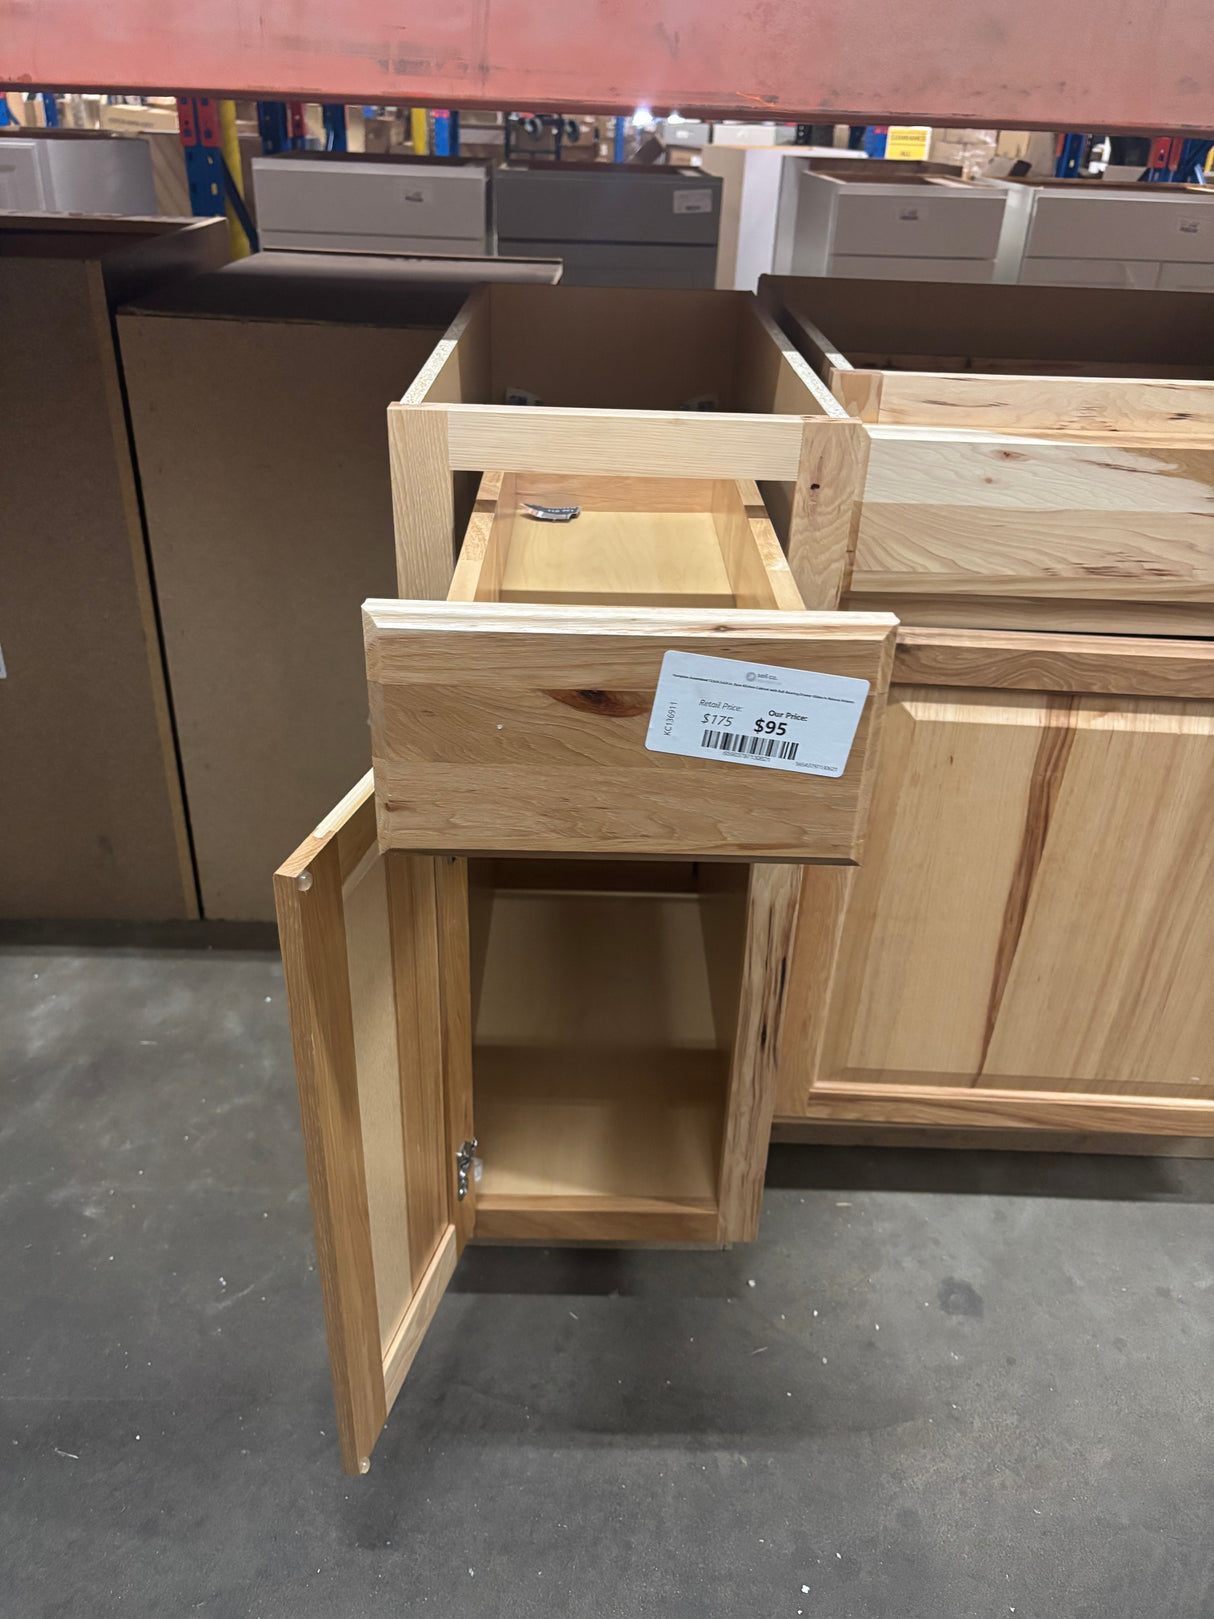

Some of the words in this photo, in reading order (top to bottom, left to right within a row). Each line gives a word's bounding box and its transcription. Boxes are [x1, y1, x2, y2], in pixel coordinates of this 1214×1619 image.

[698, 699, 721, 708] Retail
[722, 702, 743, 712] Price:
[663, 702, 678, 736] KC136911
[701, 713, 734, 727] $175
[768, 710, 784, 718] Our
[785, 712, 808, 722] Price:
[754, 717, 788, 736] $95
